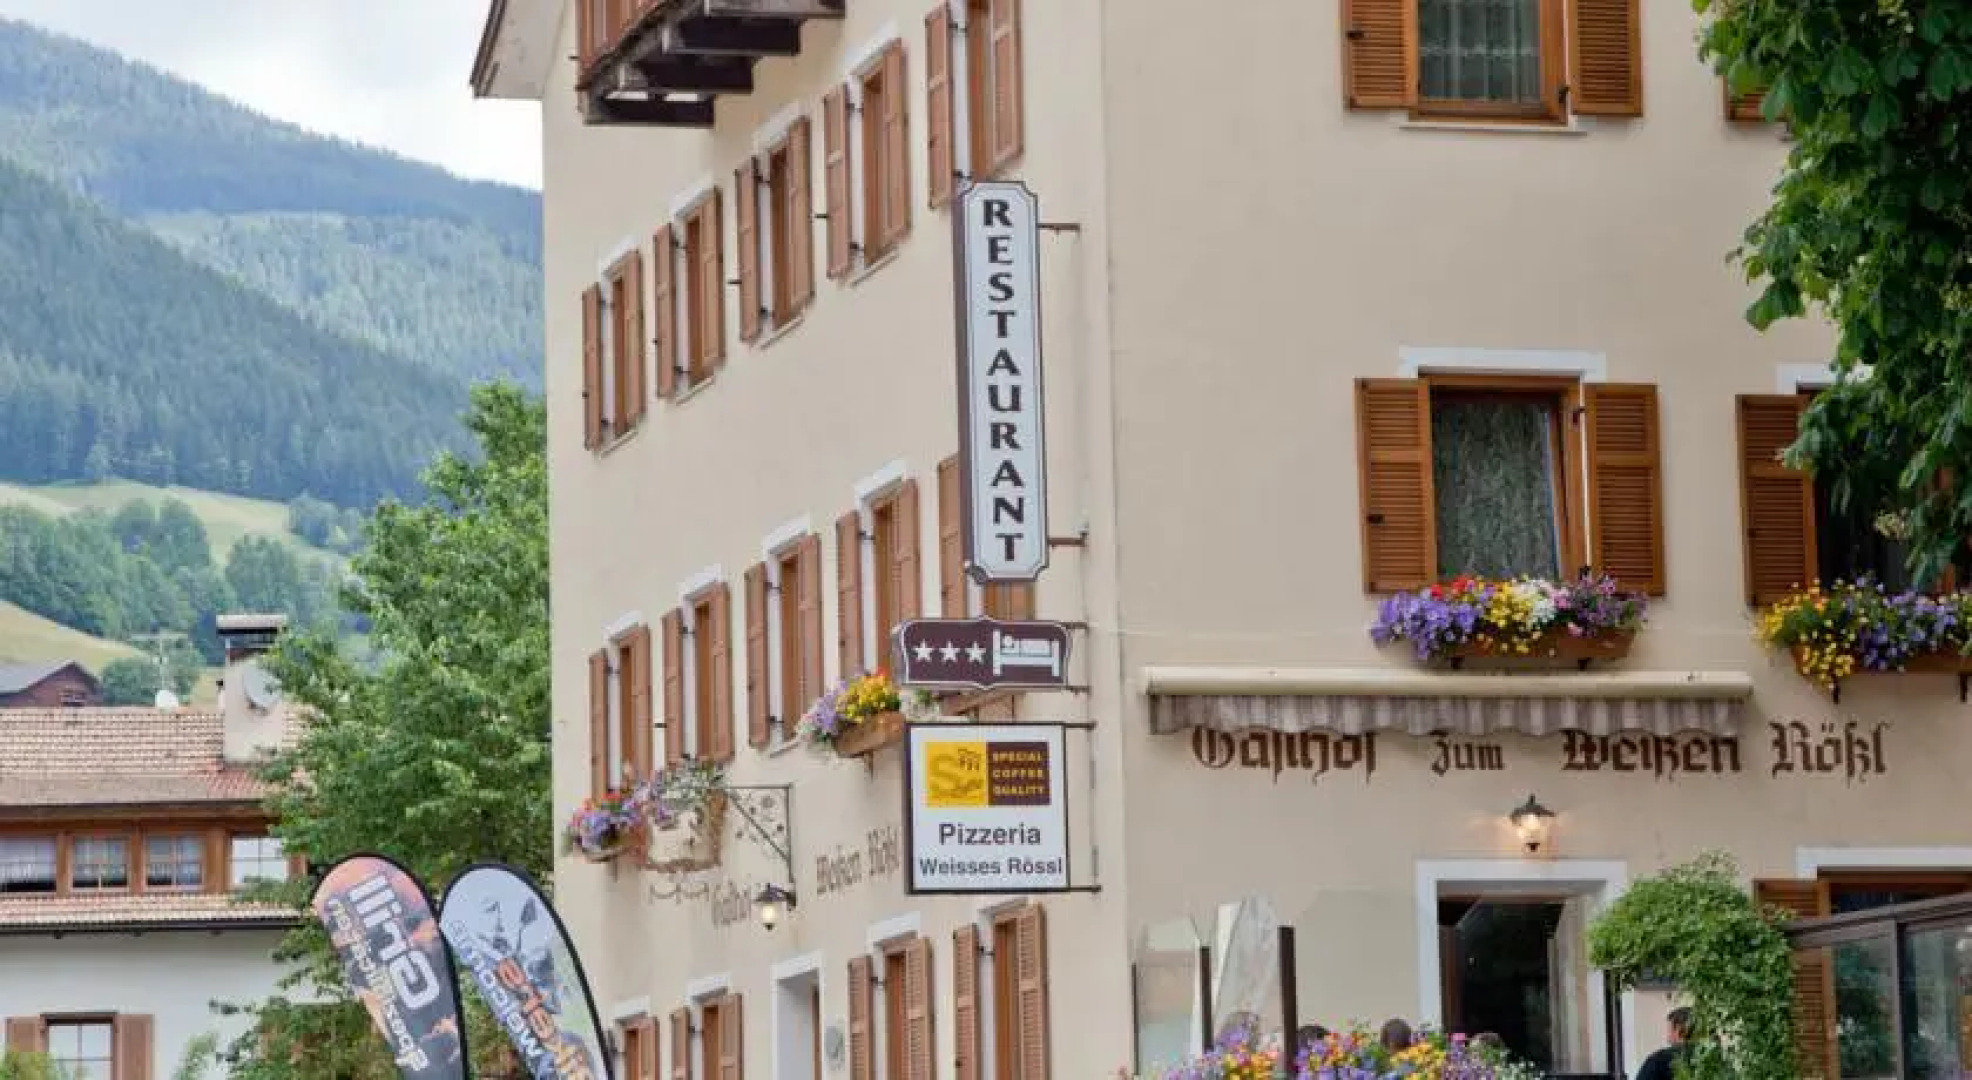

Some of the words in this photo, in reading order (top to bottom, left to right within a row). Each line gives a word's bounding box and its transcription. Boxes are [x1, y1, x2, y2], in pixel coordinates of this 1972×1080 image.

[982, 198, 1026, 563] RESTAURANT
[992, 750, 1042, 762] SPECIAL
[1768, 720, 1894, 788] Rößl
[992, 768, 1043, 779] COFFEE
[992, 785, 1044, 796] QUALITY
[938, 822, 1041, 846] Pizzeria
[919, 857, 1001, 876] Weisses
[1007, 856, 1062, 875] Rössl
